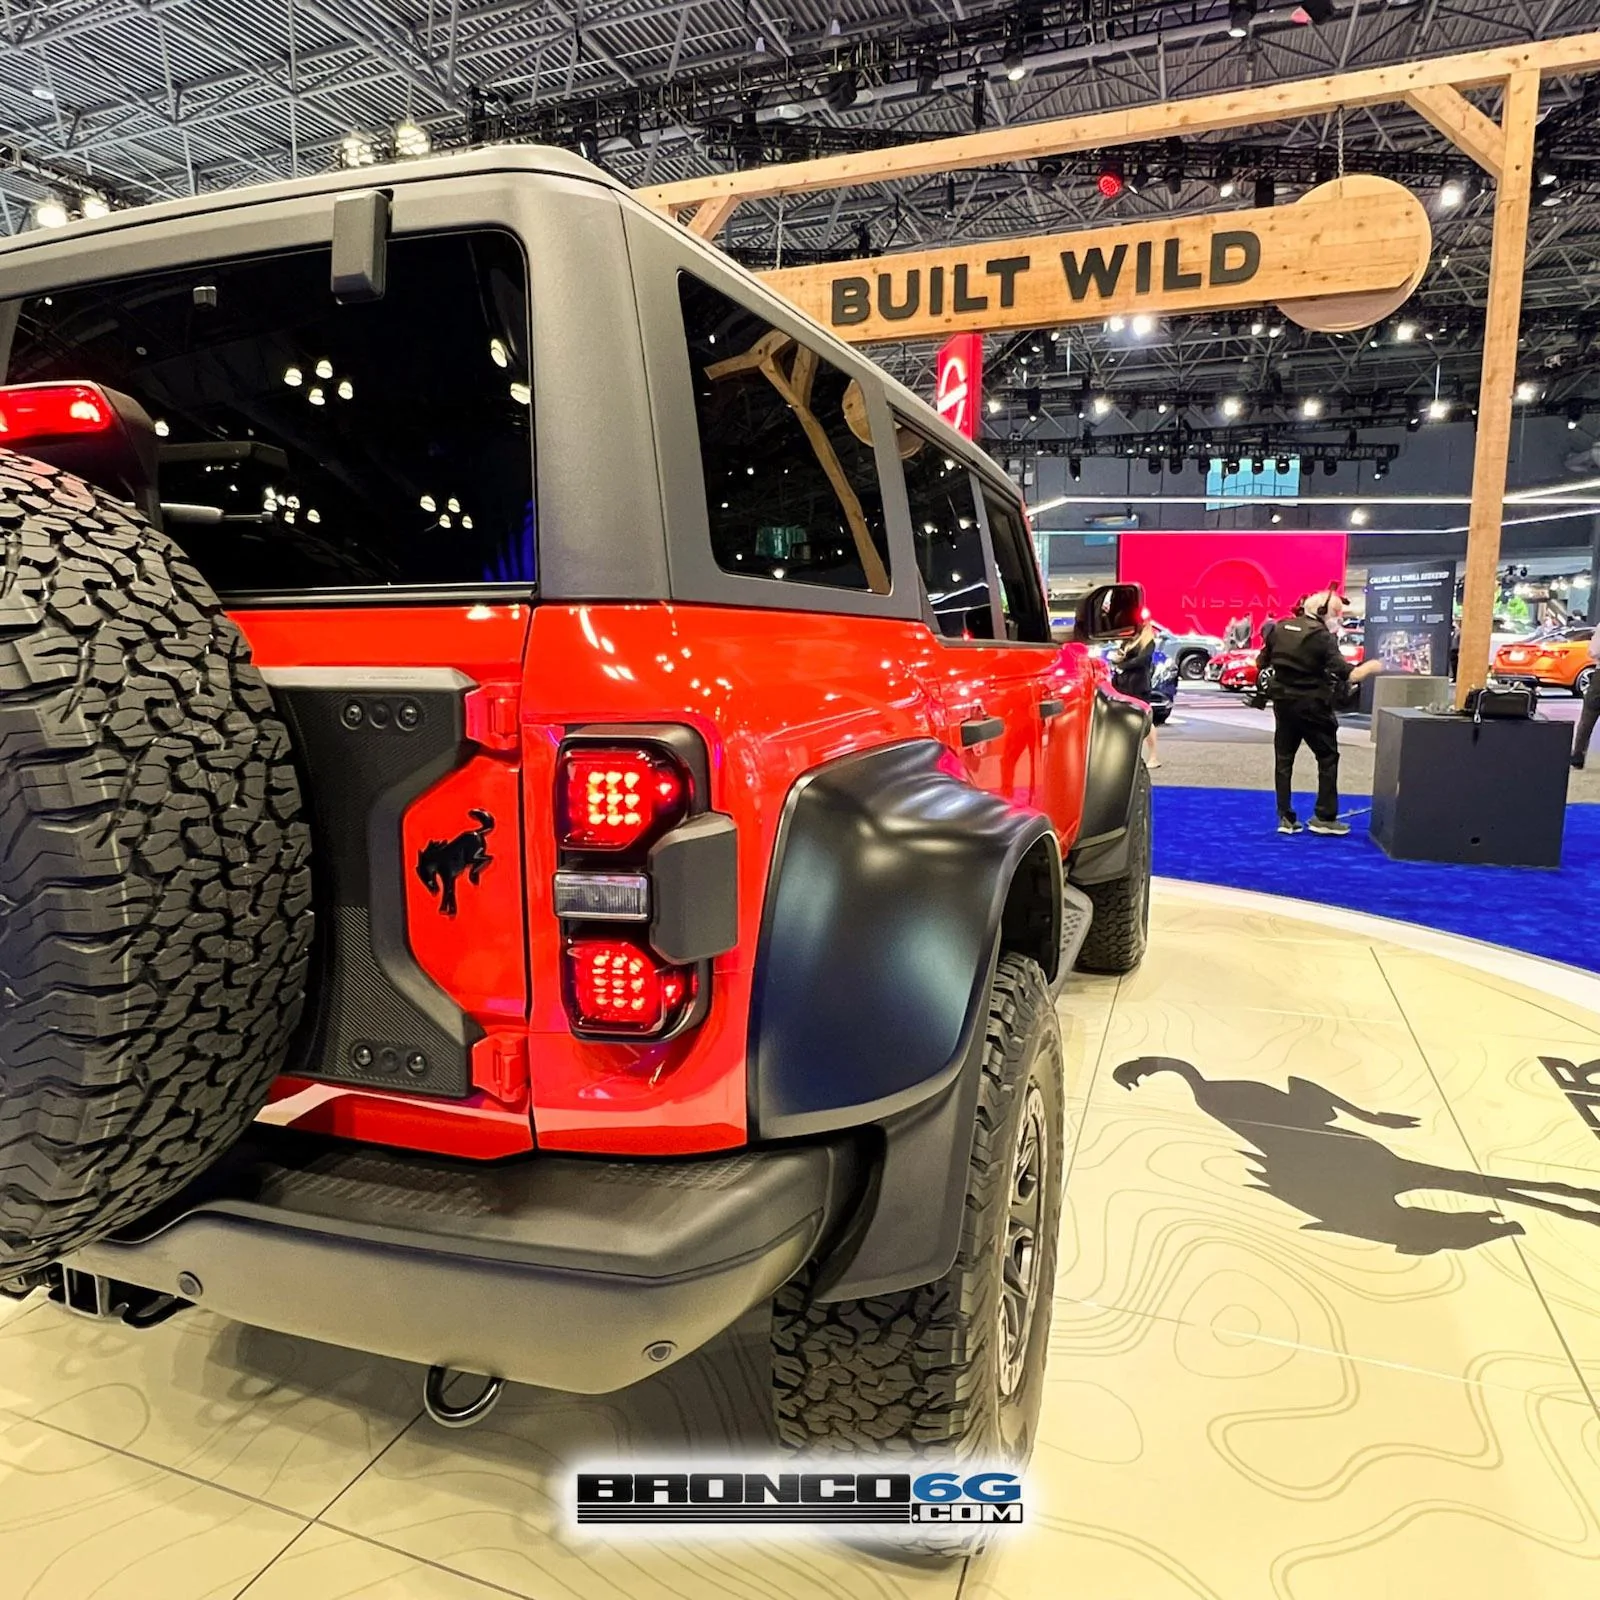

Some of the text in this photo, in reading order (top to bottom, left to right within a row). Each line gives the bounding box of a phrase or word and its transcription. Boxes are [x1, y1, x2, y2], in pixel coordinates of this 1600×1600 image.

[831, 230, 1261, 326] BUILT WILD
[1181, 594, 1281, 609] NISSAN
